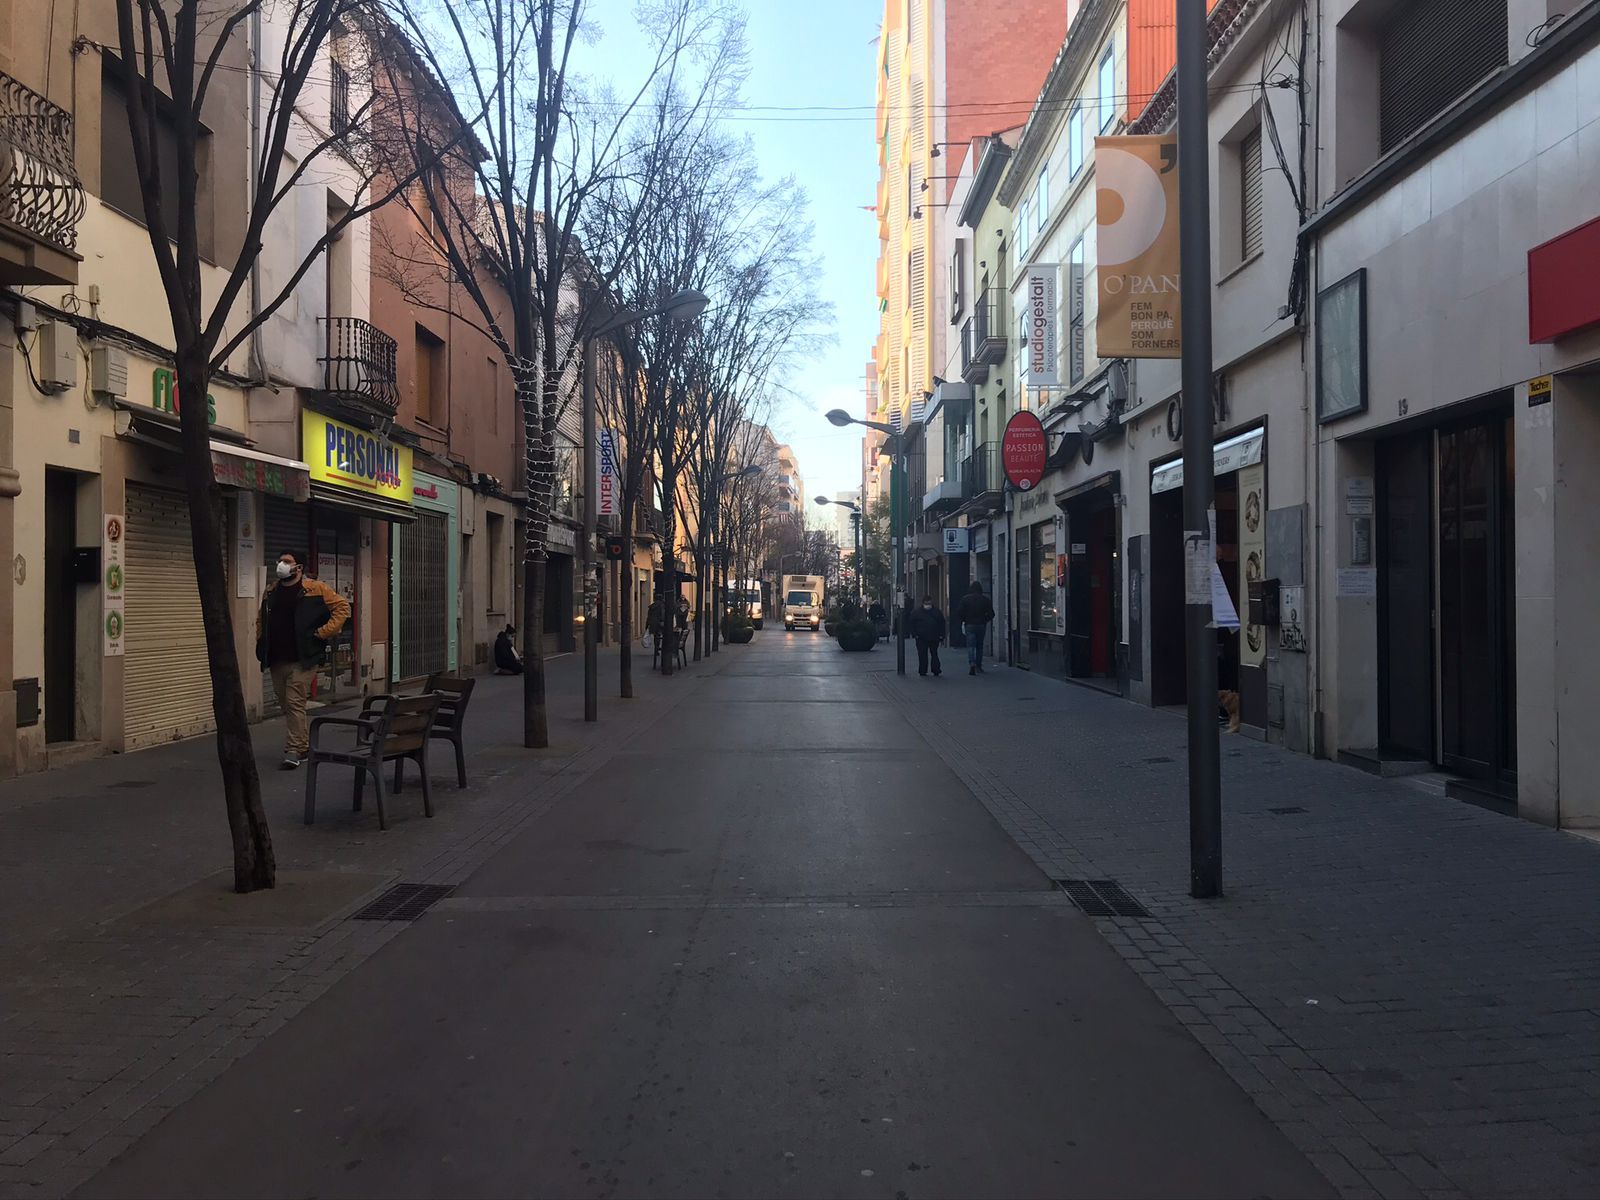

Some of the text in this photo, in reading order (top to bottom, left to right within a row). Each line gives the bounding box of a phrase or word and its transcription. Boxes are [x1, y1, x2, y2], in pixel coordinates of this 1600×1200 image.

[1131, 302, 1152, 311] FEM
[1131, 312, 1154, 320] BON
[1031, 276, 1048, 373] studiogestalt
[1131, 319, 1174, 330] PERQUÈ
[1131, 331, 1154, 340] SOM
[1131, 339, 1180, 349] FORNERS
[1398, 398, 1408, 417] 19
[1006, 443, 1044, 452] PASSION
[326, 422, 400, 485] PERSONAL
[601, 431, 612, 513] INTERSPORT
